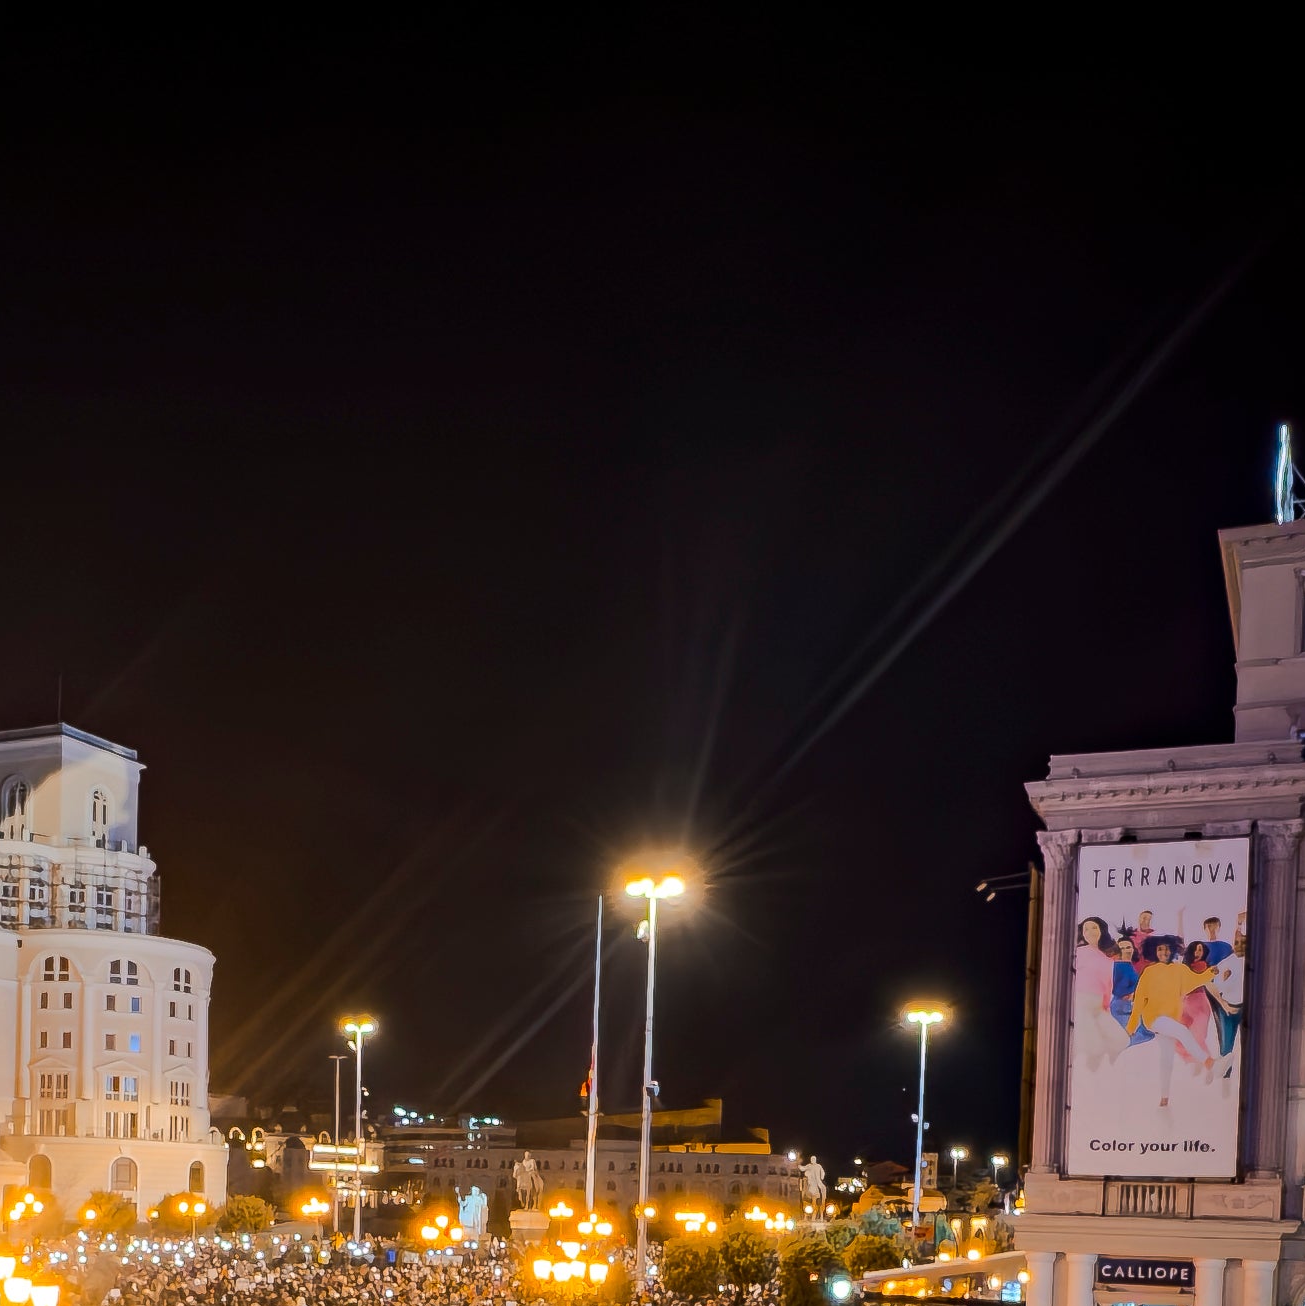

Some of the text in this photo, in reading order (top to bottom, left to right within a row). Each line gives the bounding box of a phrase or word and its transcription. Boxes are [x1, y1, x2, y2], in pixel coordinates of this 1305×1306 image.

[1092, 861, 1236, 889] TERRANOVA
[1089, 1139, 1216, 1155] Color your life.
[1101, 1264, 1189, 1280] CALLIOPE
